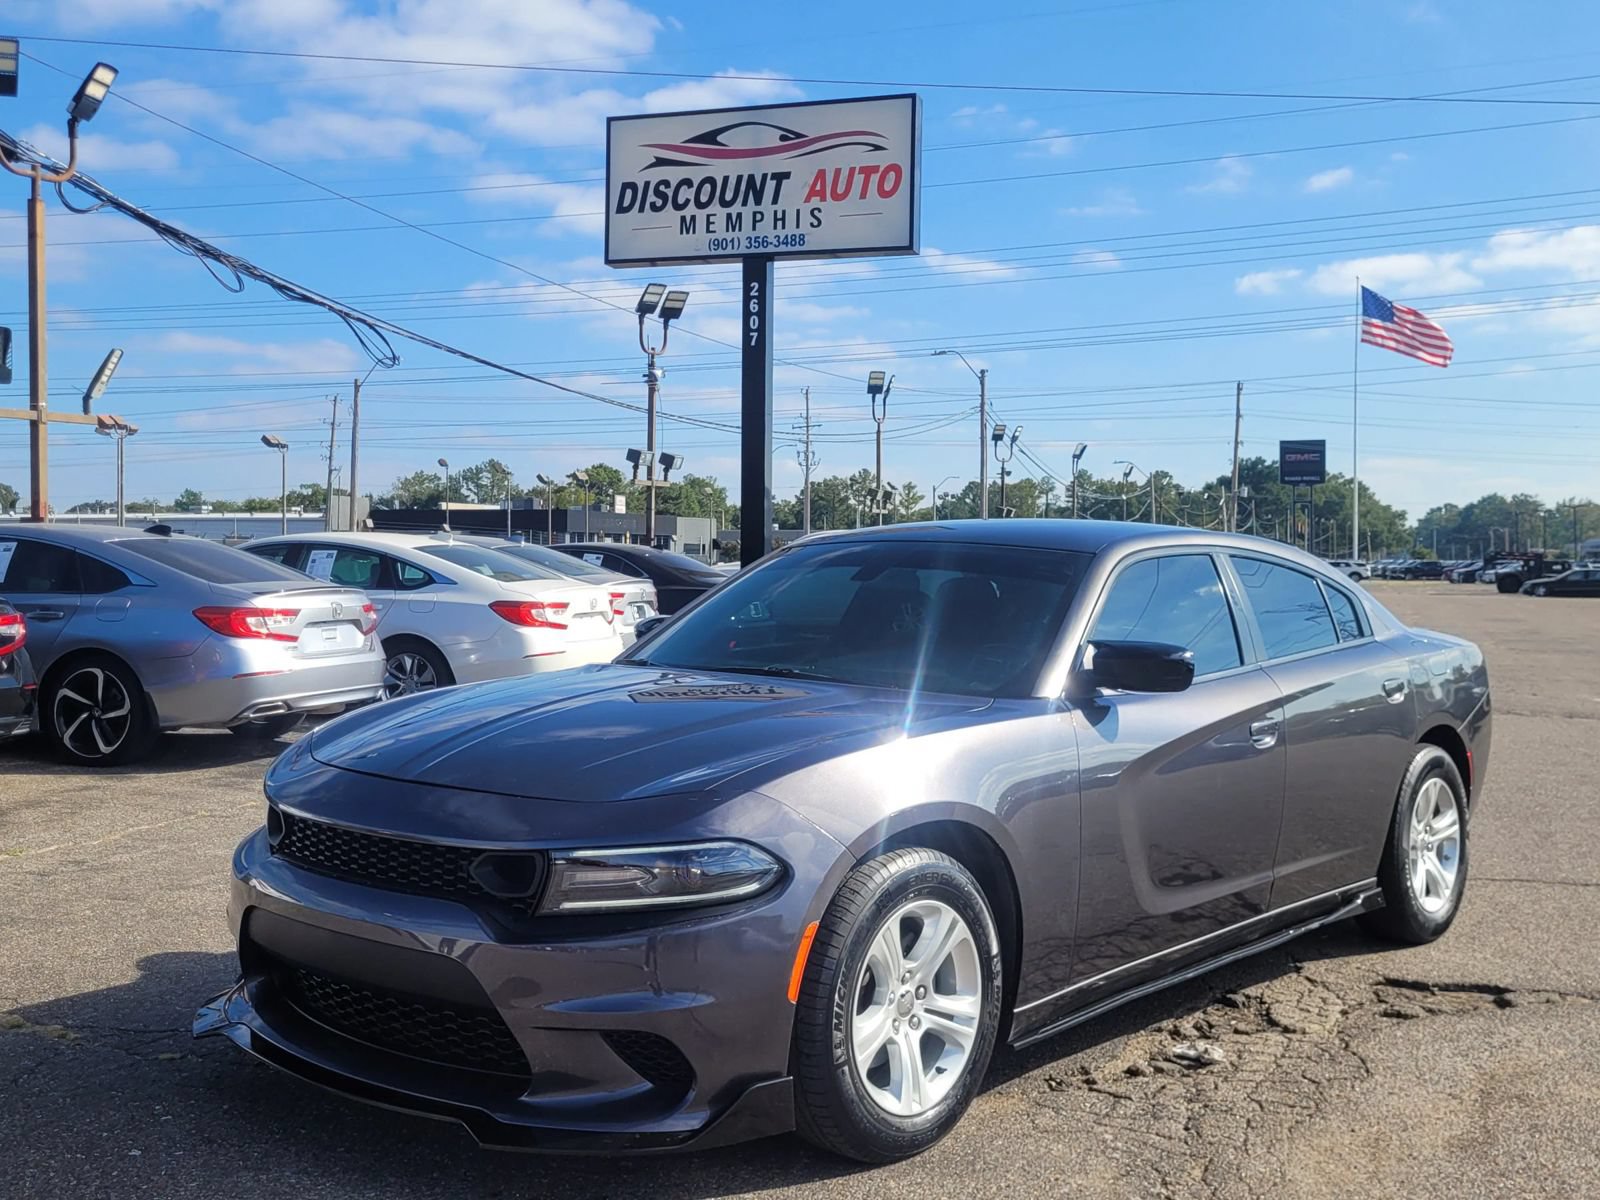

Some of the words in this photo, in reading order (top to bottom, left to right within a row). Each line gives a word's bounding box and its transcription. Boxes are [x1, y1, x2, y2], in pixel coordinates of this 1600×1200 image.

[615, 171, 791, 214] DISCOUNT
[803, 163, 903, 203] AUTO
[679, 207, 823, 235] MEMPHIS
[708, 235, 741, 251] (901)
[745, 233, 806, 249] 356-3488
[749, 282, 759, 347] 2607
[1285, 453, 1321, 461] GMC
